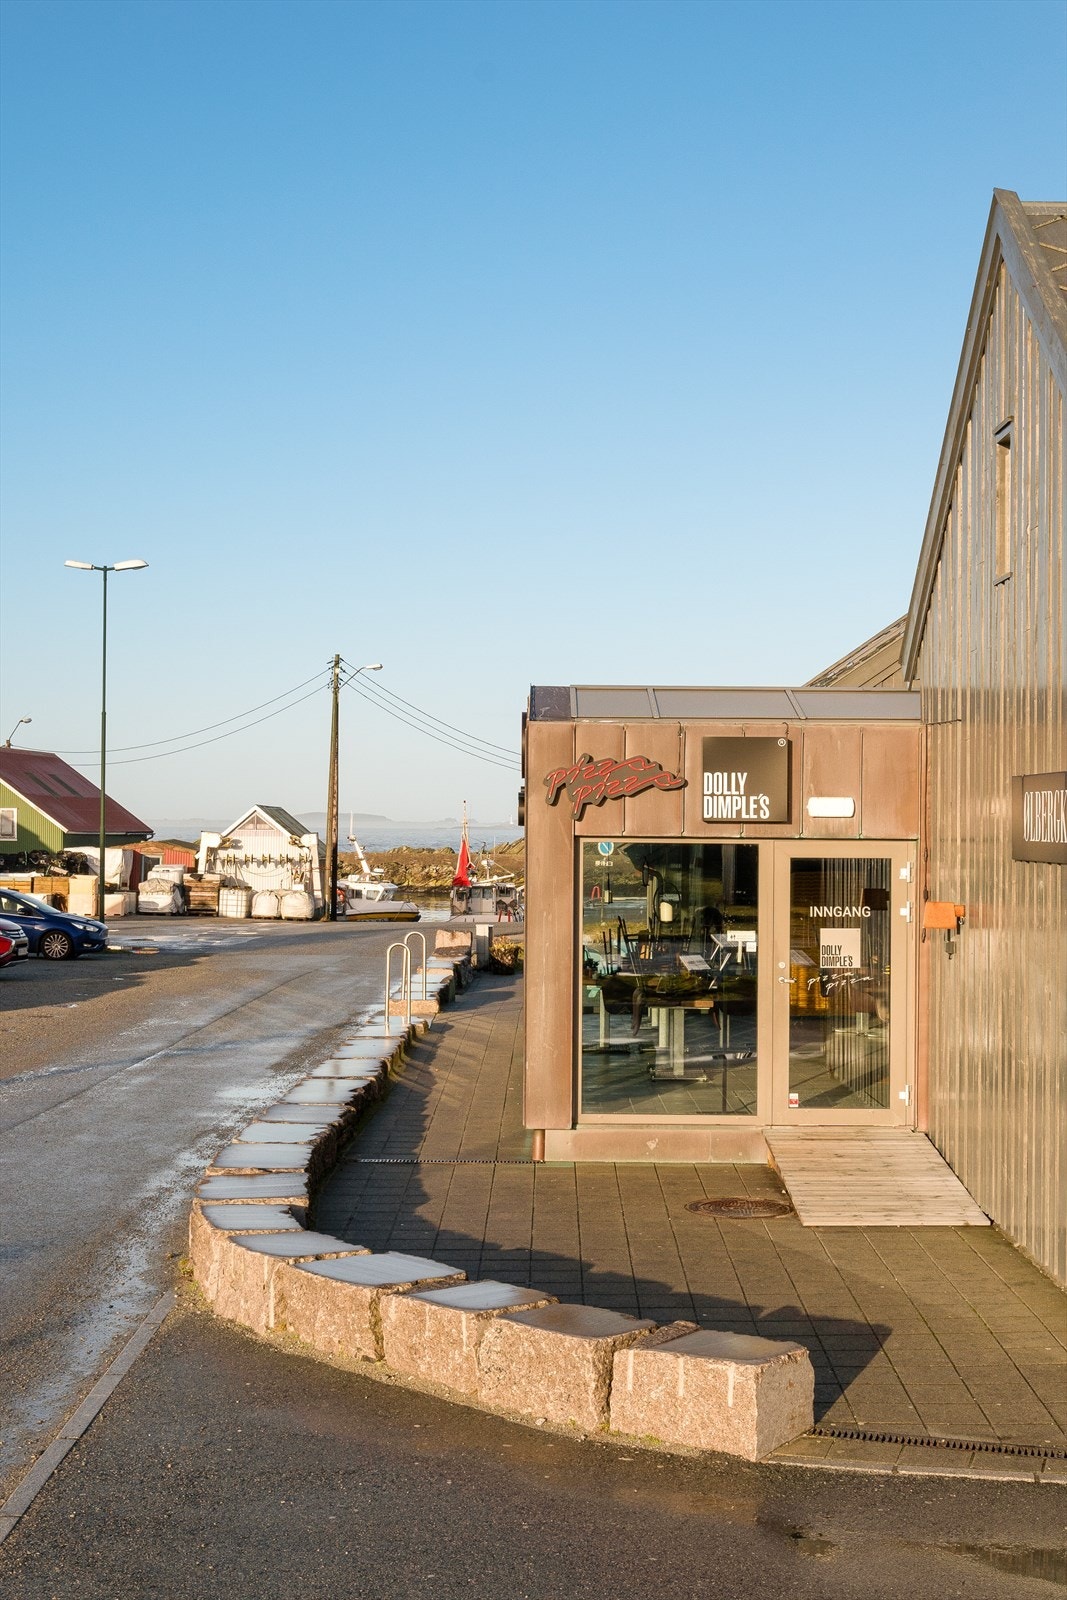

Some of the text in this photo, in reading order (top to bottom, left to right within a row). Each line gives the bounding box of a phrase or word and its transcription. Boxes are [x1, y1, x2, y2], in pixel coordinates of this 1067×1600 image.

[703, 772, 748, 795] DOLLY
[809, 906, 871, 918] INNGANG
[821, 944, 842, 956] DOLLY
